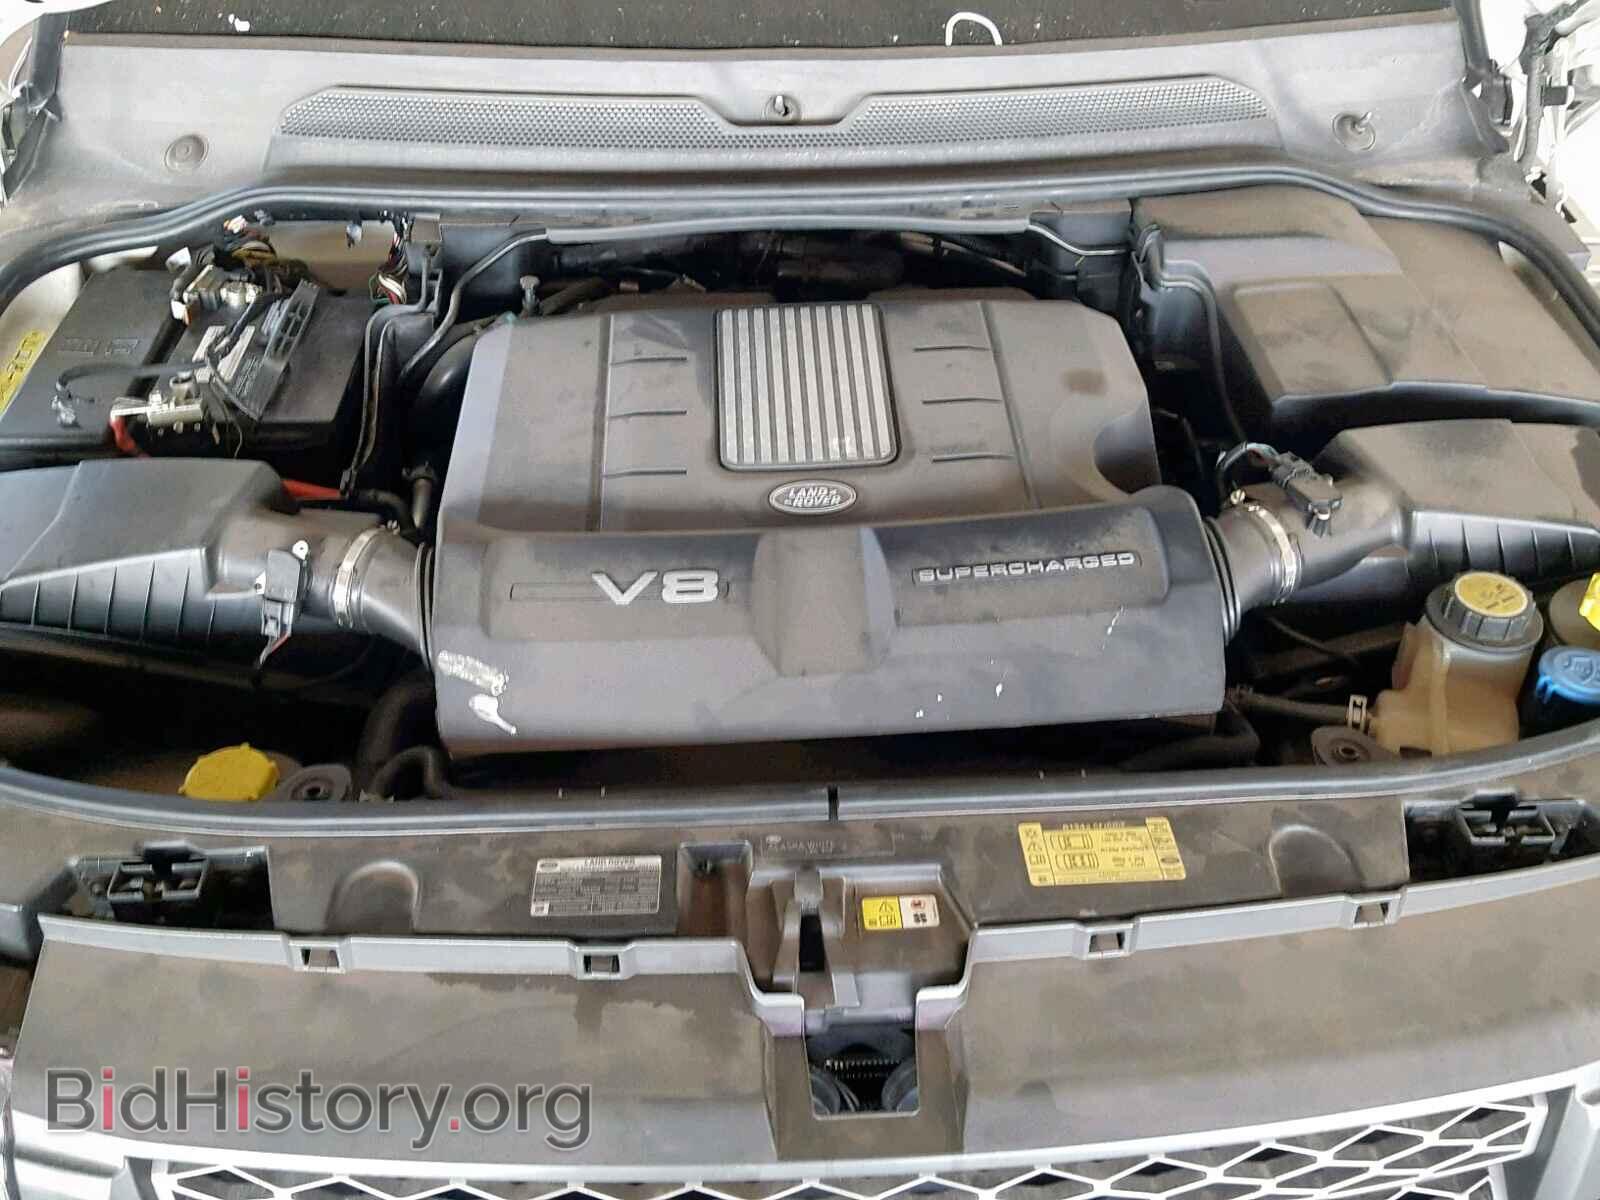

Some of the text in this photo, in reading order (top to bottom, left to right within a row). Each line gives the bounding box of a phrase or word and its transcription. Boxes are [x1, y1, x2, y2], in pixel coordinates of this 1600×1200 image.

[788, 487, 828, 499] LAND
[793, 494, 841, 507] ROVER
[919, 552, 1135, 583] SUPERCHARGED
[591, 568, 719, 606] V8
